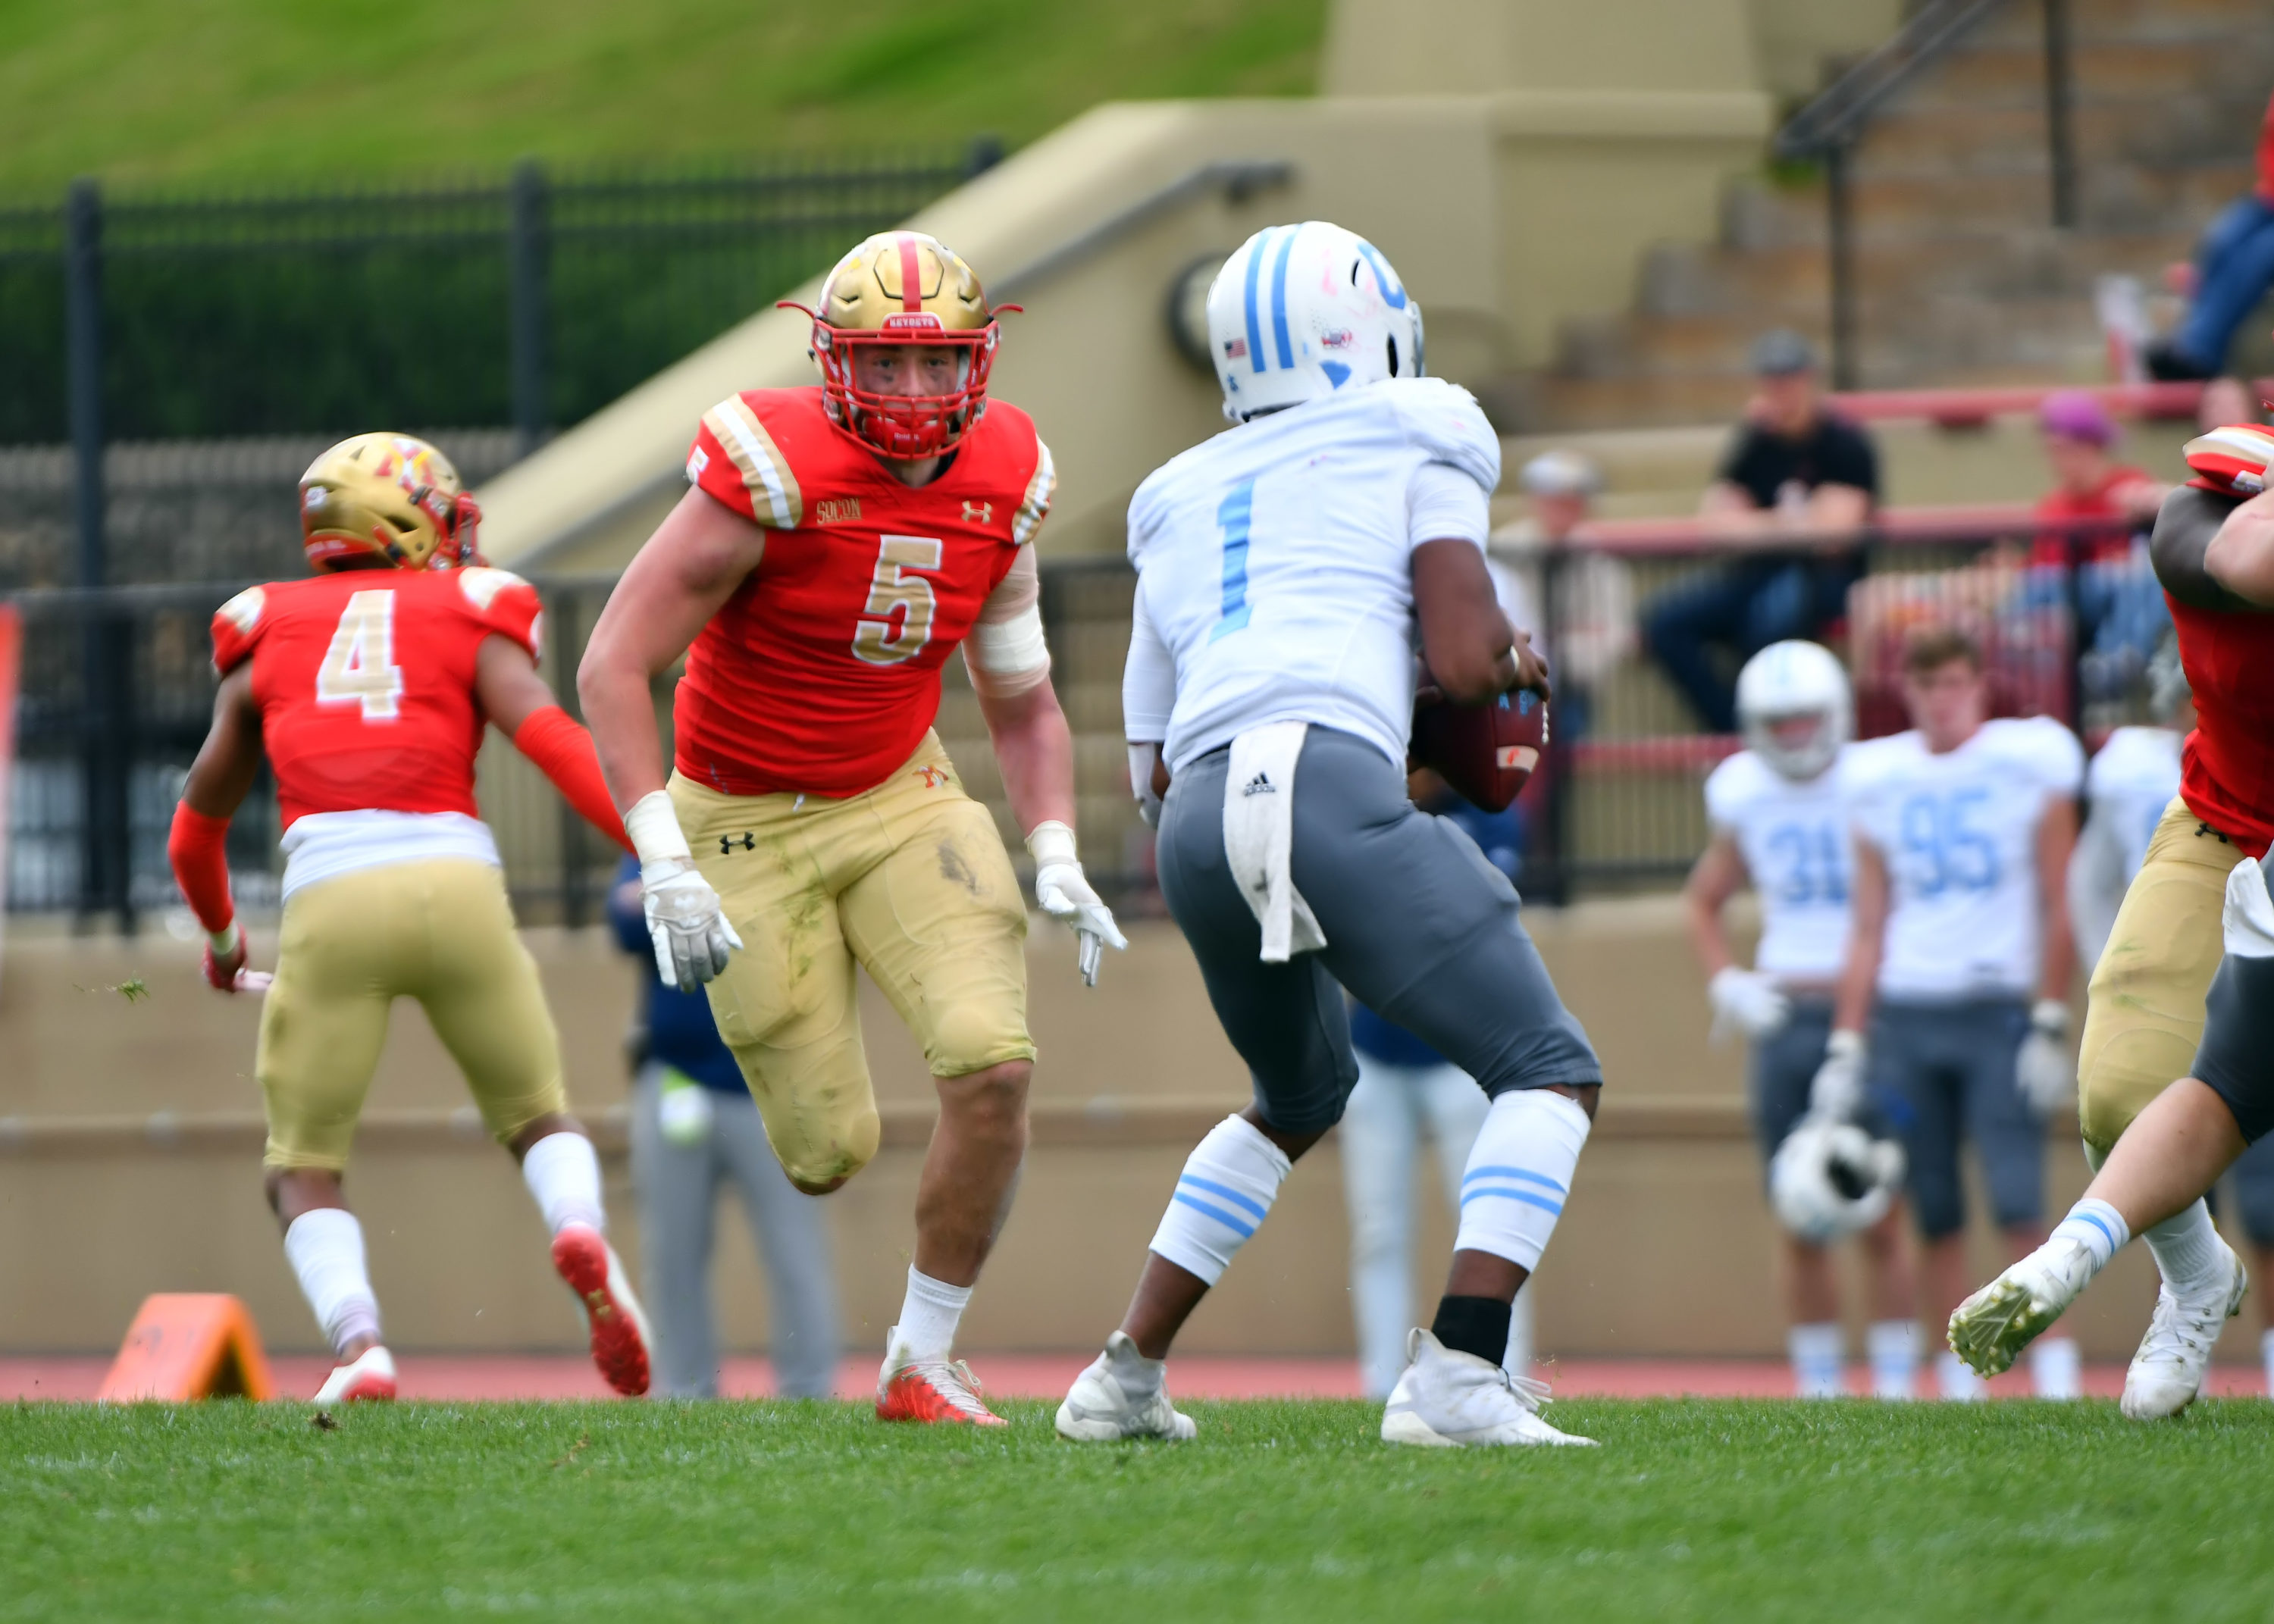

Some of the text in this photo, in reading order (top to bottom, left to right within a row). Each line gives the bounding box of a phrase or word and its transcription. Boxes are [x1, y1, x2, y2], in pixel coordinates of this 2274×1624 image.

[889, 317, 935, 327] KEYDETS
[816, 497, 862, 526] SOCON
[1208, 478, 1254, 645] 1
[315, 588, 404, 721] 4
[850, 534, 942, 665] 5
[1900, 788, 2000, 894] 95
